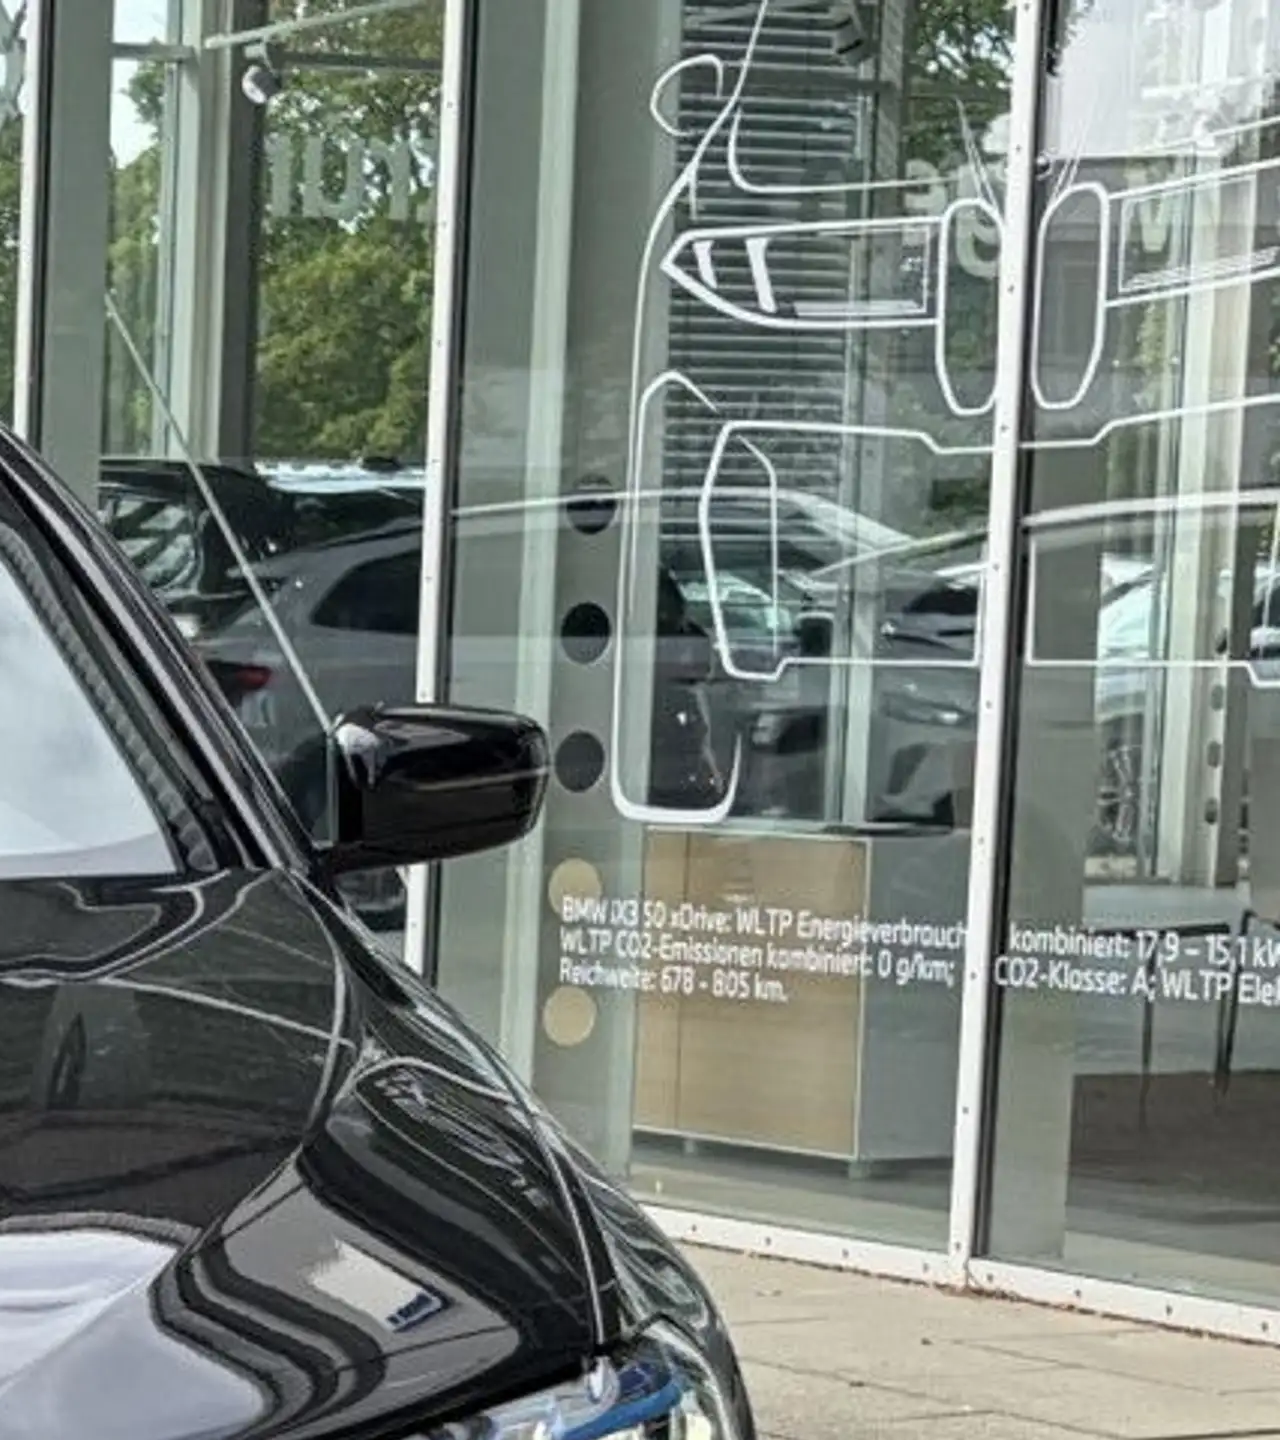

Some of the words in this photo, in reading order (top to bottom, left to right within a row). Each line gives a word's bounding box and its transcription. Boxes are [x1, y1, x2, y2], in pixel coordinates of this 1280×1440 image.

[559, 924, 613, 955] WLTP
[766, 941, 873, 976] kombiniert:
[994, 955, 1126, 995] CO2-Klasse:
[1130, 965, 1157, 1002] A;
[1160, 968, 1233, 1002] WLTP
[561, 895, 610, 925] BMW
[670, 902, 733, 934] xDrive:
[735, 906, 793, 937] WLTP
[1009, 921, 1130, 959] kombiniert:
[1136, 930, 1181, 967] 17,9
[1205, 934, 1246, 973] 15,1
[659, 964, 697, 996] 678
